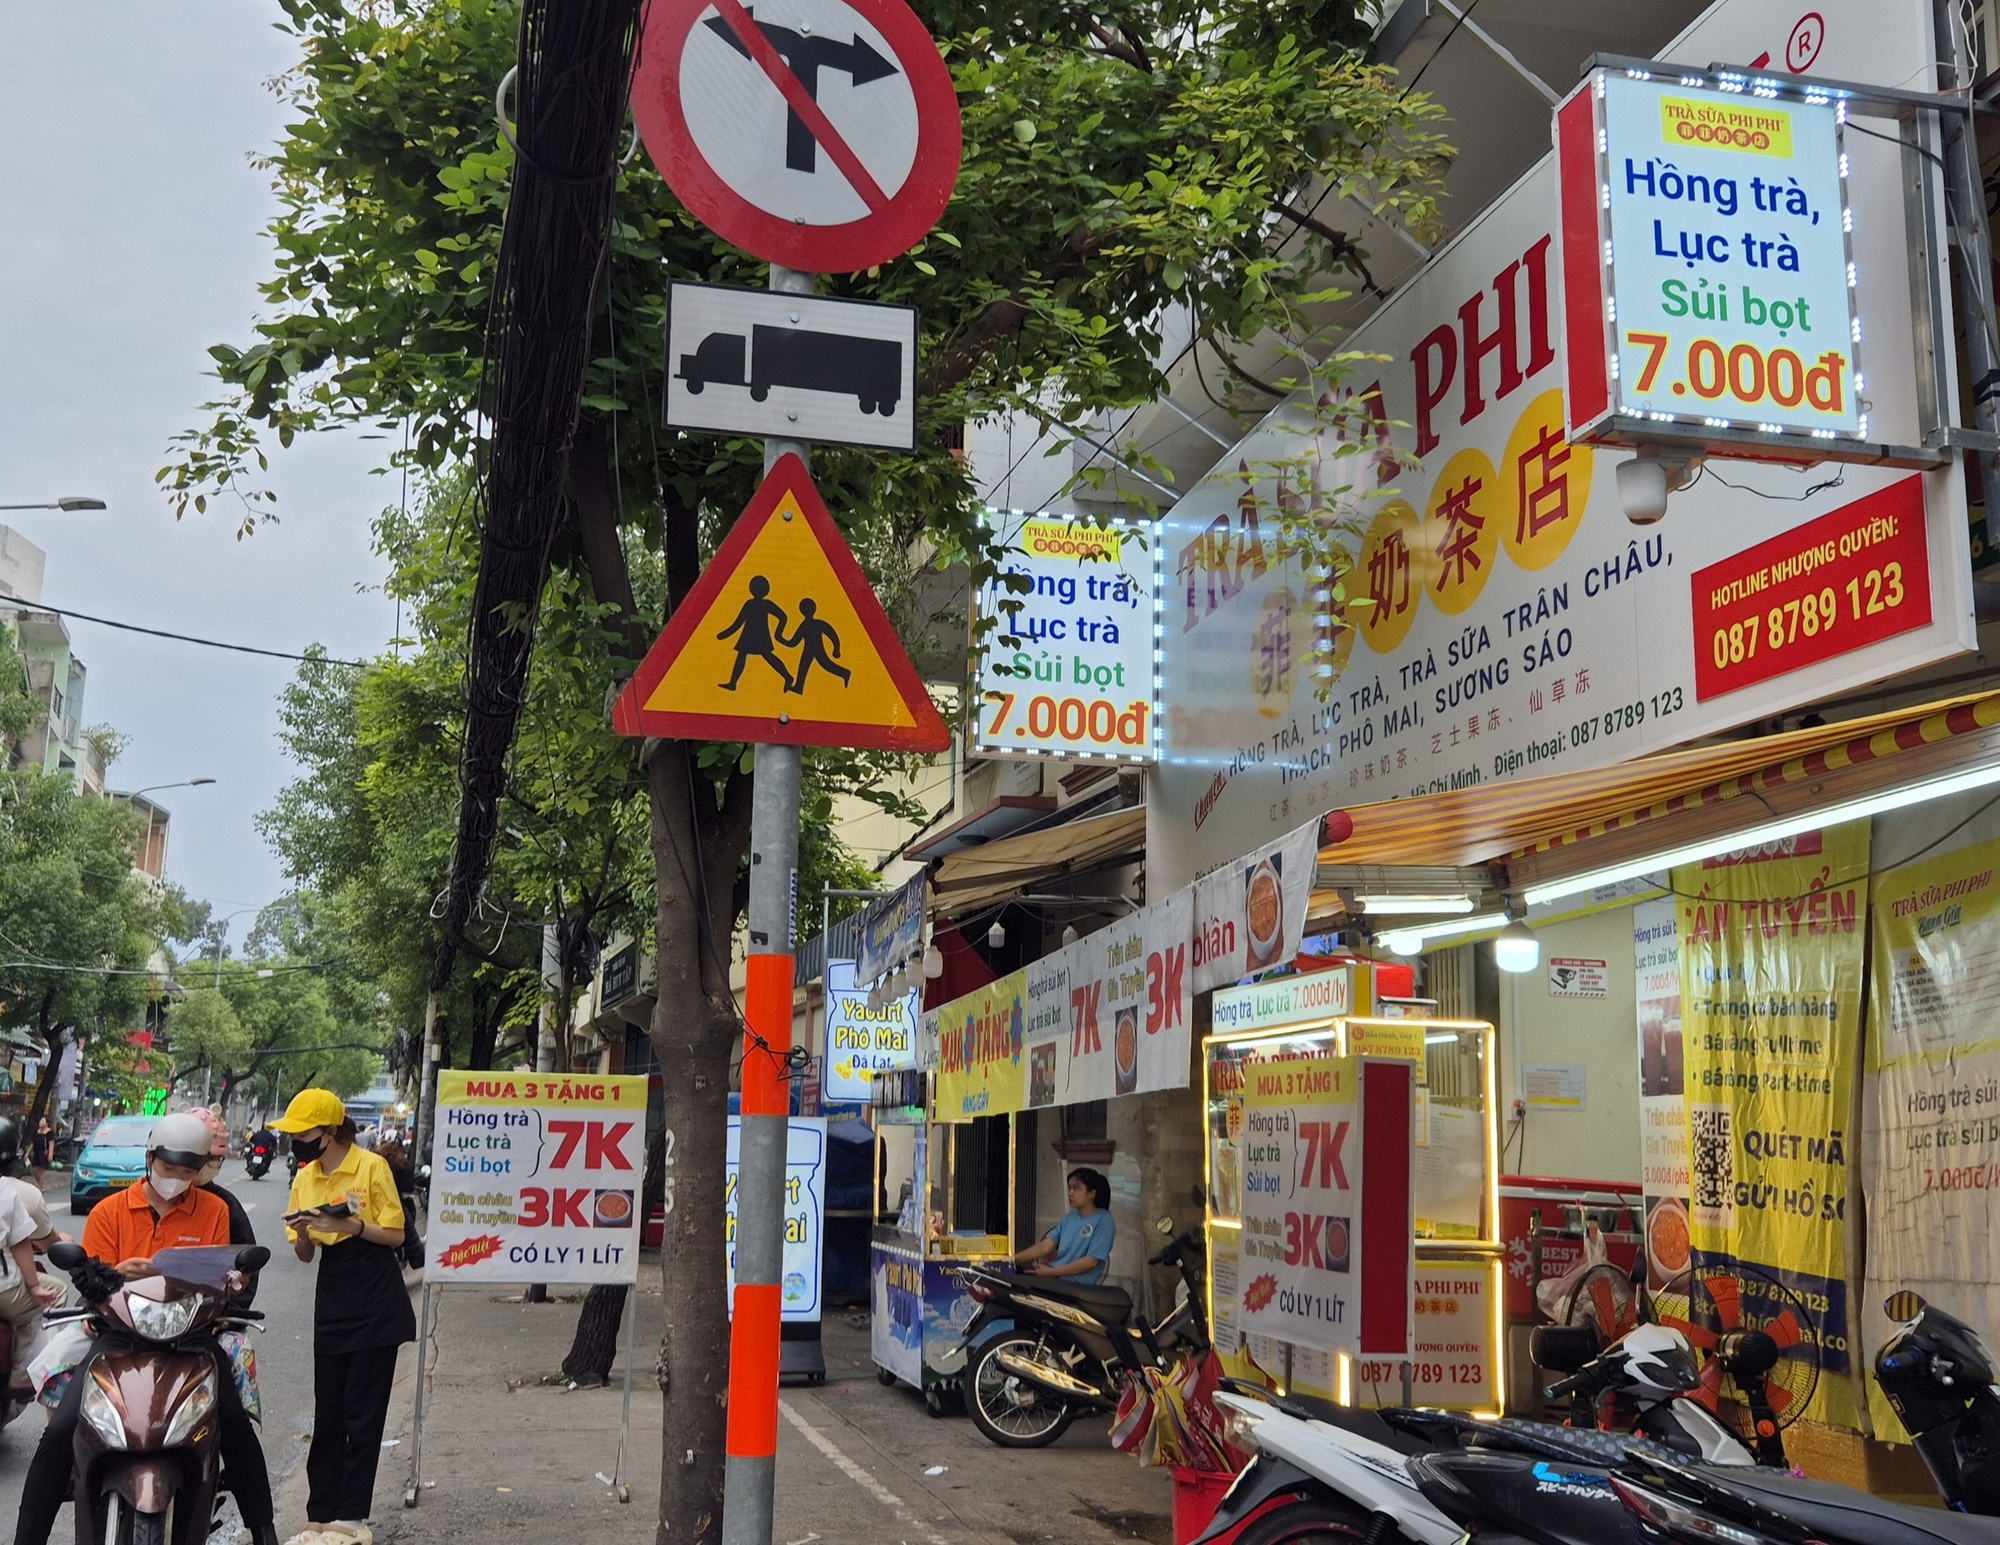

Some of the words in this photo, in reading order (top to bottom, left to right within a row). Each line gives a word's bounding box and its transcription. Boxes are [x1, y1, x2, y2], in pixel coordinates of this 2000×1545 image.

[1665, 102, 1696, 121] TRÀ
[1697, 106, 1727, 125] SỮA
[1729, 113, 1754, 129] PHI
[1756, 117, 1781, 132] PHI
[1624, 157, 1738, 217] Hồng
[1750, 176, 1821, 226] trà,
[1653, 219, 1730, 268] Lục
[1741, 232, 1800, 273] trà
[1660, 278, 1728, 323] Sủi
[1743, 286, 1812, 338] bọt
[1409, 232, 1556, 461] PHI
[1625, 331, 1846, 414] 7.000đ
[1711, 567, 1768, 611] HOTLINE
[1771, 540, 1836, 585] NHƯỢNG
[1839, 514, 1900, 558] QUYỀN:
[1086, 573, 1138, 609] trà,
[1009, 613, 1066, 644] Lục
[1076, 616, 1120, 645] trà
[1713, 614, 1760, 671] 087
[1767, 586, 1837, 650] 8789
[1845, 561, 1905, 621] 123
[1272, 719, 1304, 755] TRÀ,
[1312, 701, 1341, 736] LỤC
[1350, 675, 1389, 715] TRÀ,
[1399, 648, 1437, 691] TRÀ
[1447, 624, 1491, 667] SỮA
[1502, 582, 1569, 639] TRÂN
[1584, 533, 1673, 598] CHÂU,
[1012, 650, 1062, 683] Sủi
[1073, 655, 1125, 693] bọt
[983, 692, 1149, 745] 7.000đ
[1280, 750, 1331, 785] THẠCH
[1339, 718, 1374, 759] PHÔ
[1383, 700, 1424, 739] MAI,
[1435, 657, 1509, 714] SƯƠNG
[1523, 627, 1573, 673] SÁO
[1450, 763, 1481, 791] Minh
[1494, 748, 1524, 777] Điện
[1527, 730, 1566, 762] thoại:
[1571, 716, 1599, 747] 087
[1603, 700, 1645, 736] 8789
[1651, 687, 1684, 719] 123
[1740, 865, 1856, 940] TUYỂN
[1892, 891, 1919, 918] TRÀ
[1920, 885, 1942, 910] SỮA
[1944, 879, 1969, 899] PHI
[1966, 870, 1993, 893] PHI
[1107, 941, 1124, 969] Trân
[1125, 932, 1143, 962] châu
[1634, 926, 1651, 945] Hồng
[1652, 922, 1660, 940] trà
[1662, 920, 1672, 937] sủi
[1635, 956, 1646, 973] Lục
[1647, 951, 1657, 967] trà
[1145, 942, 1185, 1036] 3K
[1214, 998, 1237, 1026] Hồng
[1239, 993, 1254, 1022] trà,
[1256, 996, 1274, 1021] Lục
[1276, 987, 1290, 1013] trà
[1293, 976, 1346, 1010] 7.000đ/ly
[1072, 979, 1102, 1058] 7K
[1800, 996, 1837, 1021] hàng
[835, 1026, 871, 1050] Phô
[875, 1028, 909, 1051] Mai
[941, 1027, 964, 1075] MUA
[976, 1000, 1010, 1079] TẶNG
[1354, 1045, 1373, 1055] 087
[1375, 1044, 1401, 1055] 8789
[1403, 1046, 1421, 1056] 123
[466, 1081, 518, 1099] MUA
[524, 1082, 538, 1098] 3
[544, 1079, 605, 1104] TẶNG
[611, 1085, 621, 1101] 1
[1257, 1074, 1283, 1097] MUA
[1286, 1074, 1294, 1095] 3
[1296, 1066, 1331, 1100] TẶNG
[1334, 1070, 1341, 1092] 1
[1907, 1089, 1946, 1116] Hồng
[1949, 1084, 1971, 1106] trà
[1975, 1078, 1998, 1104] sủi
[448, 1109, 499, 1130] Hồng
[504, 1110, 529, 1127] trà
[1248, 1110, 1273, 1137] Hồng
[1275, 1110, 1289, 1132] trà
[446, 1133, 480, 1152] Lục
[485, 1132, 511, 1150] trà
[547, 1121, 636, 1171] 7K
[1247, 1142, 1265, 1167] Lục
[1266, 1142, 1281, 1163] trà
[1299, 1121, 1350, 1191] 7K
[1744, 1127, 1802, 1163] QUÉT
[1808, 1130, 1845, 1167] MÃ
[1906, 1129, 1932, 1156] Lục
[1936, 1125, 1958, 1147] trà
[444, 1155, 475, 1173] Sủi
[480, 1157, 511, 1179] bọt
[1247, 1170, 1263, 1192] Sủi
[1264, 1175, 1281, 1198] bọt
[441, 1191, 475, 1206] Trân
[477, 1192, 513, 1207] châu
[518, 1187, 592, 1228] 3K
[1784, 1178, 1815, 1217] HỒ
[440, 1210, 463, 1224] Gia
[469, 1207, 517, 1228] Truyền
[509, 1243, 538, 1264] CÓ
[544, 1247, 569, 1264] LY
[576, 1247, 584, 1264] 1
[593, 1243, 625, 1265] LÍT
[1284, 1211, 1325, 1270] 3K
[1541, 1247, 1580, 1261] BEST
[1279, 1286, 1295, 1313] CÓ
[1298, 1295, 1313, 1316] LY
[1316, 1298, 1321, 1319] 1
[1325, 1294, 1345, 1323] LÍT
[1425, 1280, 1451, 1294] PHI
[1454, 1281, 1479, 1295] PHI
[1805, 1292, 1830, 1313] 123
[1445, 1341, 1481, 1353] QUYỀN:
[1361, 1363, 1391, 1383] 087
[1450, 1364, 1482, 1384] 123
